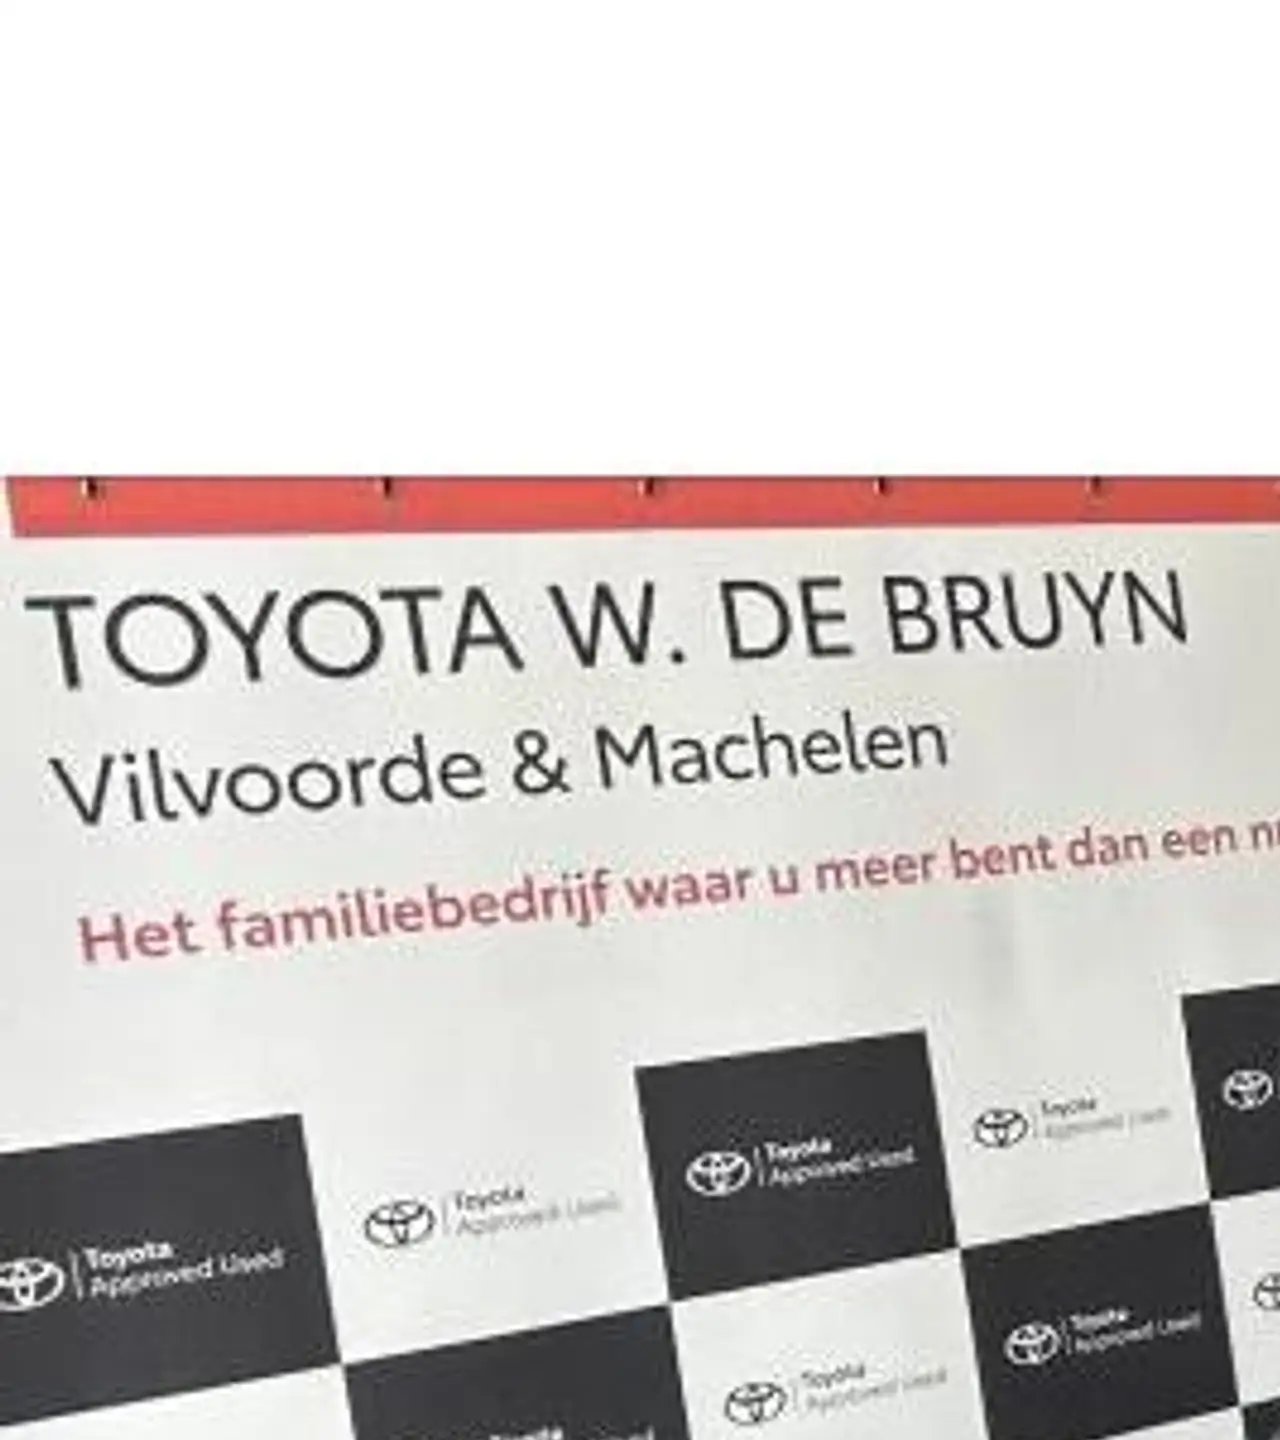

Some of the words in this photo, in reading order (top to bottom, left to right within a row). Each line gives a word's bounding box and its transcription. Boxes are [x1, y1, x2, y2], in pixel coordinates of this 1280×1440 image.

[24, 585, 524, 690] TOYOTA
[548, 581, 685, 668] W.
[720, 576, 853, 661] DE
[883, 570, 1187, 655] BRUYN
[48, 733, 486, 826] Vilvoorde
[513, 729, 571, 796] &
[595, 709, 948, 789] Machelen
[78, 911, 202, 962] Het
[217, 868, 610, 952] familiebedrijf
[624, 871, 751, 910] waar
[770, 865, 800, 896] u
[816, 851, 936, 892] meer
[949, 834, 1056, 878] bent
[1068, 826, 1149, 867] dan
[1161, 824, 1240, 858] een
[82, 1240, 174, 1272] Toyota
[90, 1256, 213, 1301] Approved
[220, 1246, 286, 1276] Used
